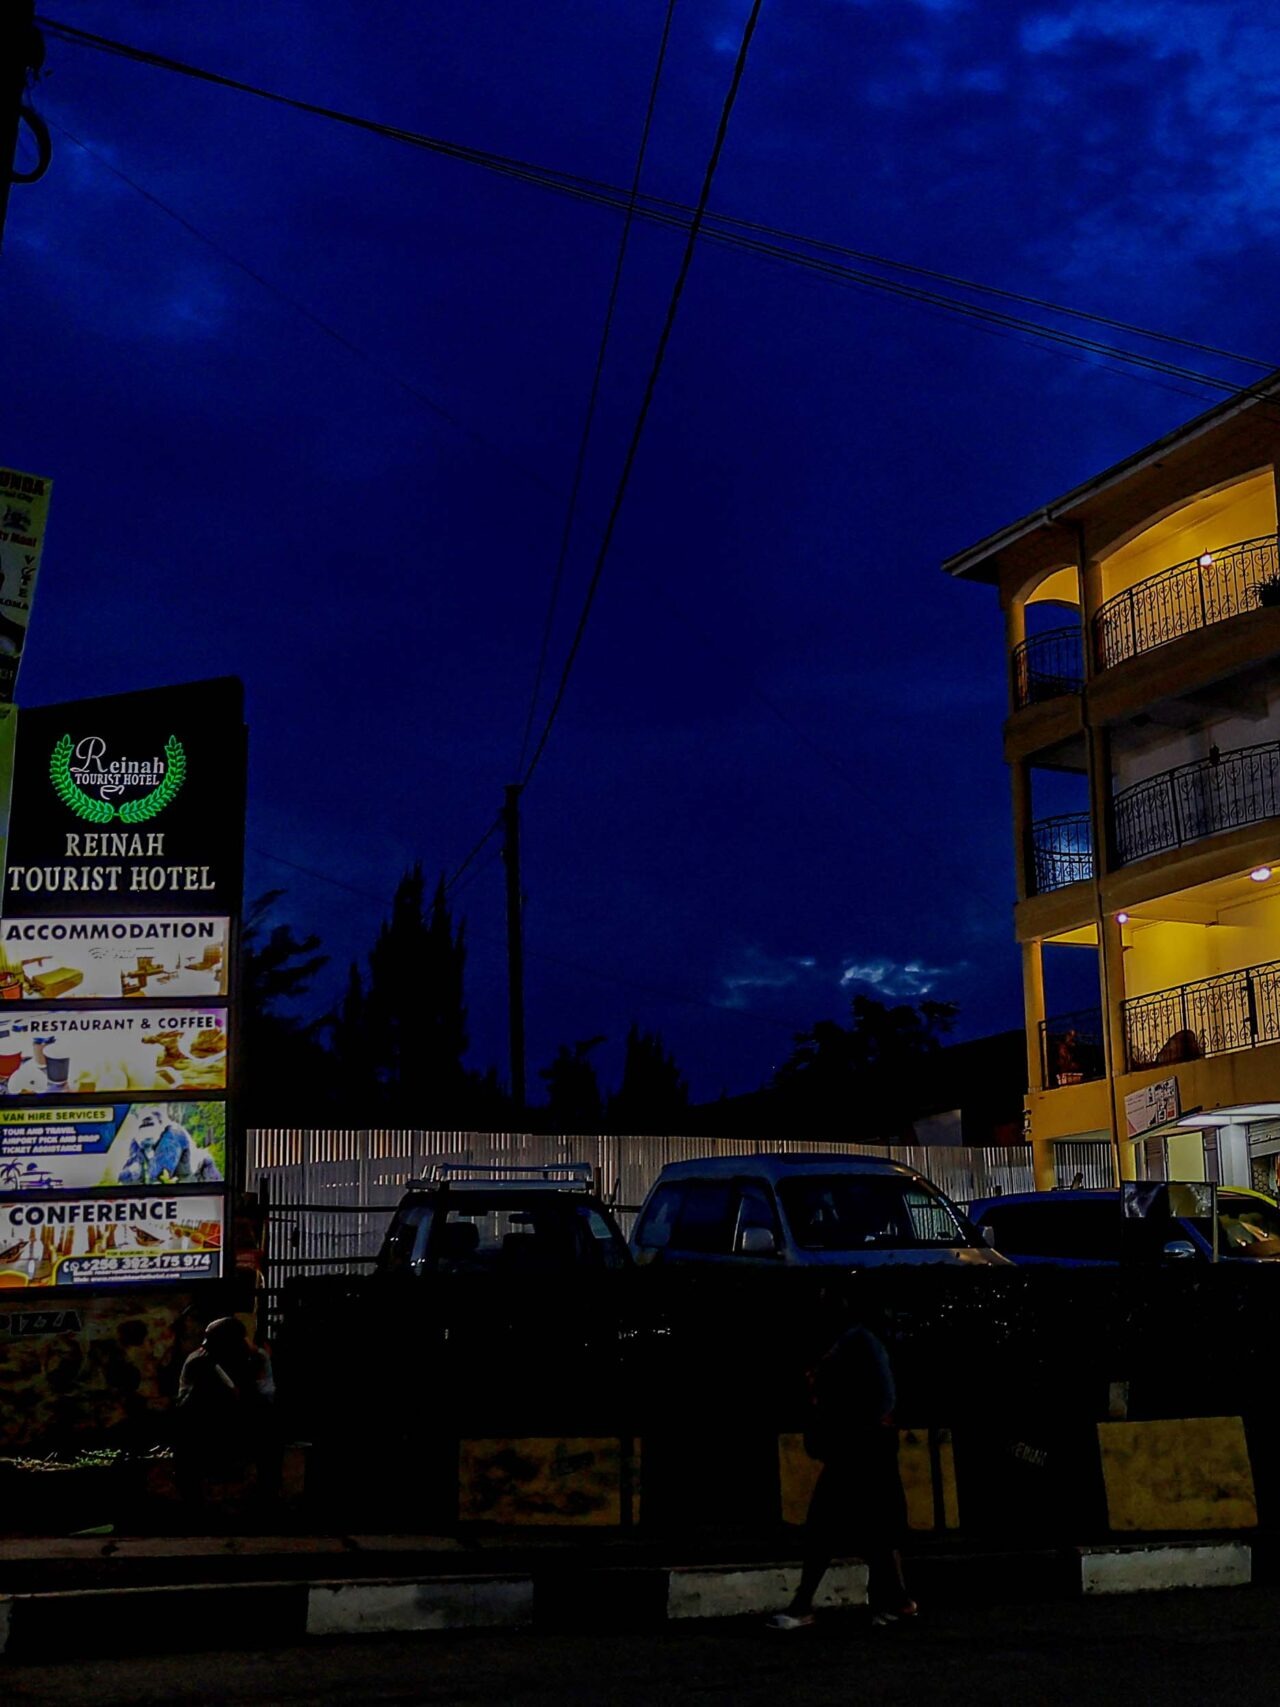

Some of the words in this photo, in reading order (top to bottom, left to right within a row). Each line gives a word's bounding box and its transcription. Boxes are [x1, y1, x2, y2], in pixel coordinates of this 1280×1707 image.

[70, 736, 165, 774] Reinah
[75, 773, 121, 786] TOURIST
[124, 773, 160, 786] HOTEL
[64, 833, 165, 857] REINAH
[8, 866, 122, 892] TOURIST
[129, 865, 216, 891] HOTEL
[6, 922, 214, 941] ACCOMMODATION
[30, 1018, 134, 1032] RESTAURANT
[140, 1018, 151, 1029] &
[159, 1016, 213, 1029] COFFEE
[3, 1113, 24, 1121] VAN
[28, 1112, 52, 1120] HIRE
[56, 1111, 106, 1120] SERVICES
[3, 1128, 25, 1136] TOUR
[9, 1201, 178, 1225] CONFERENCE
[184, 1254, 211, 1267] 974
